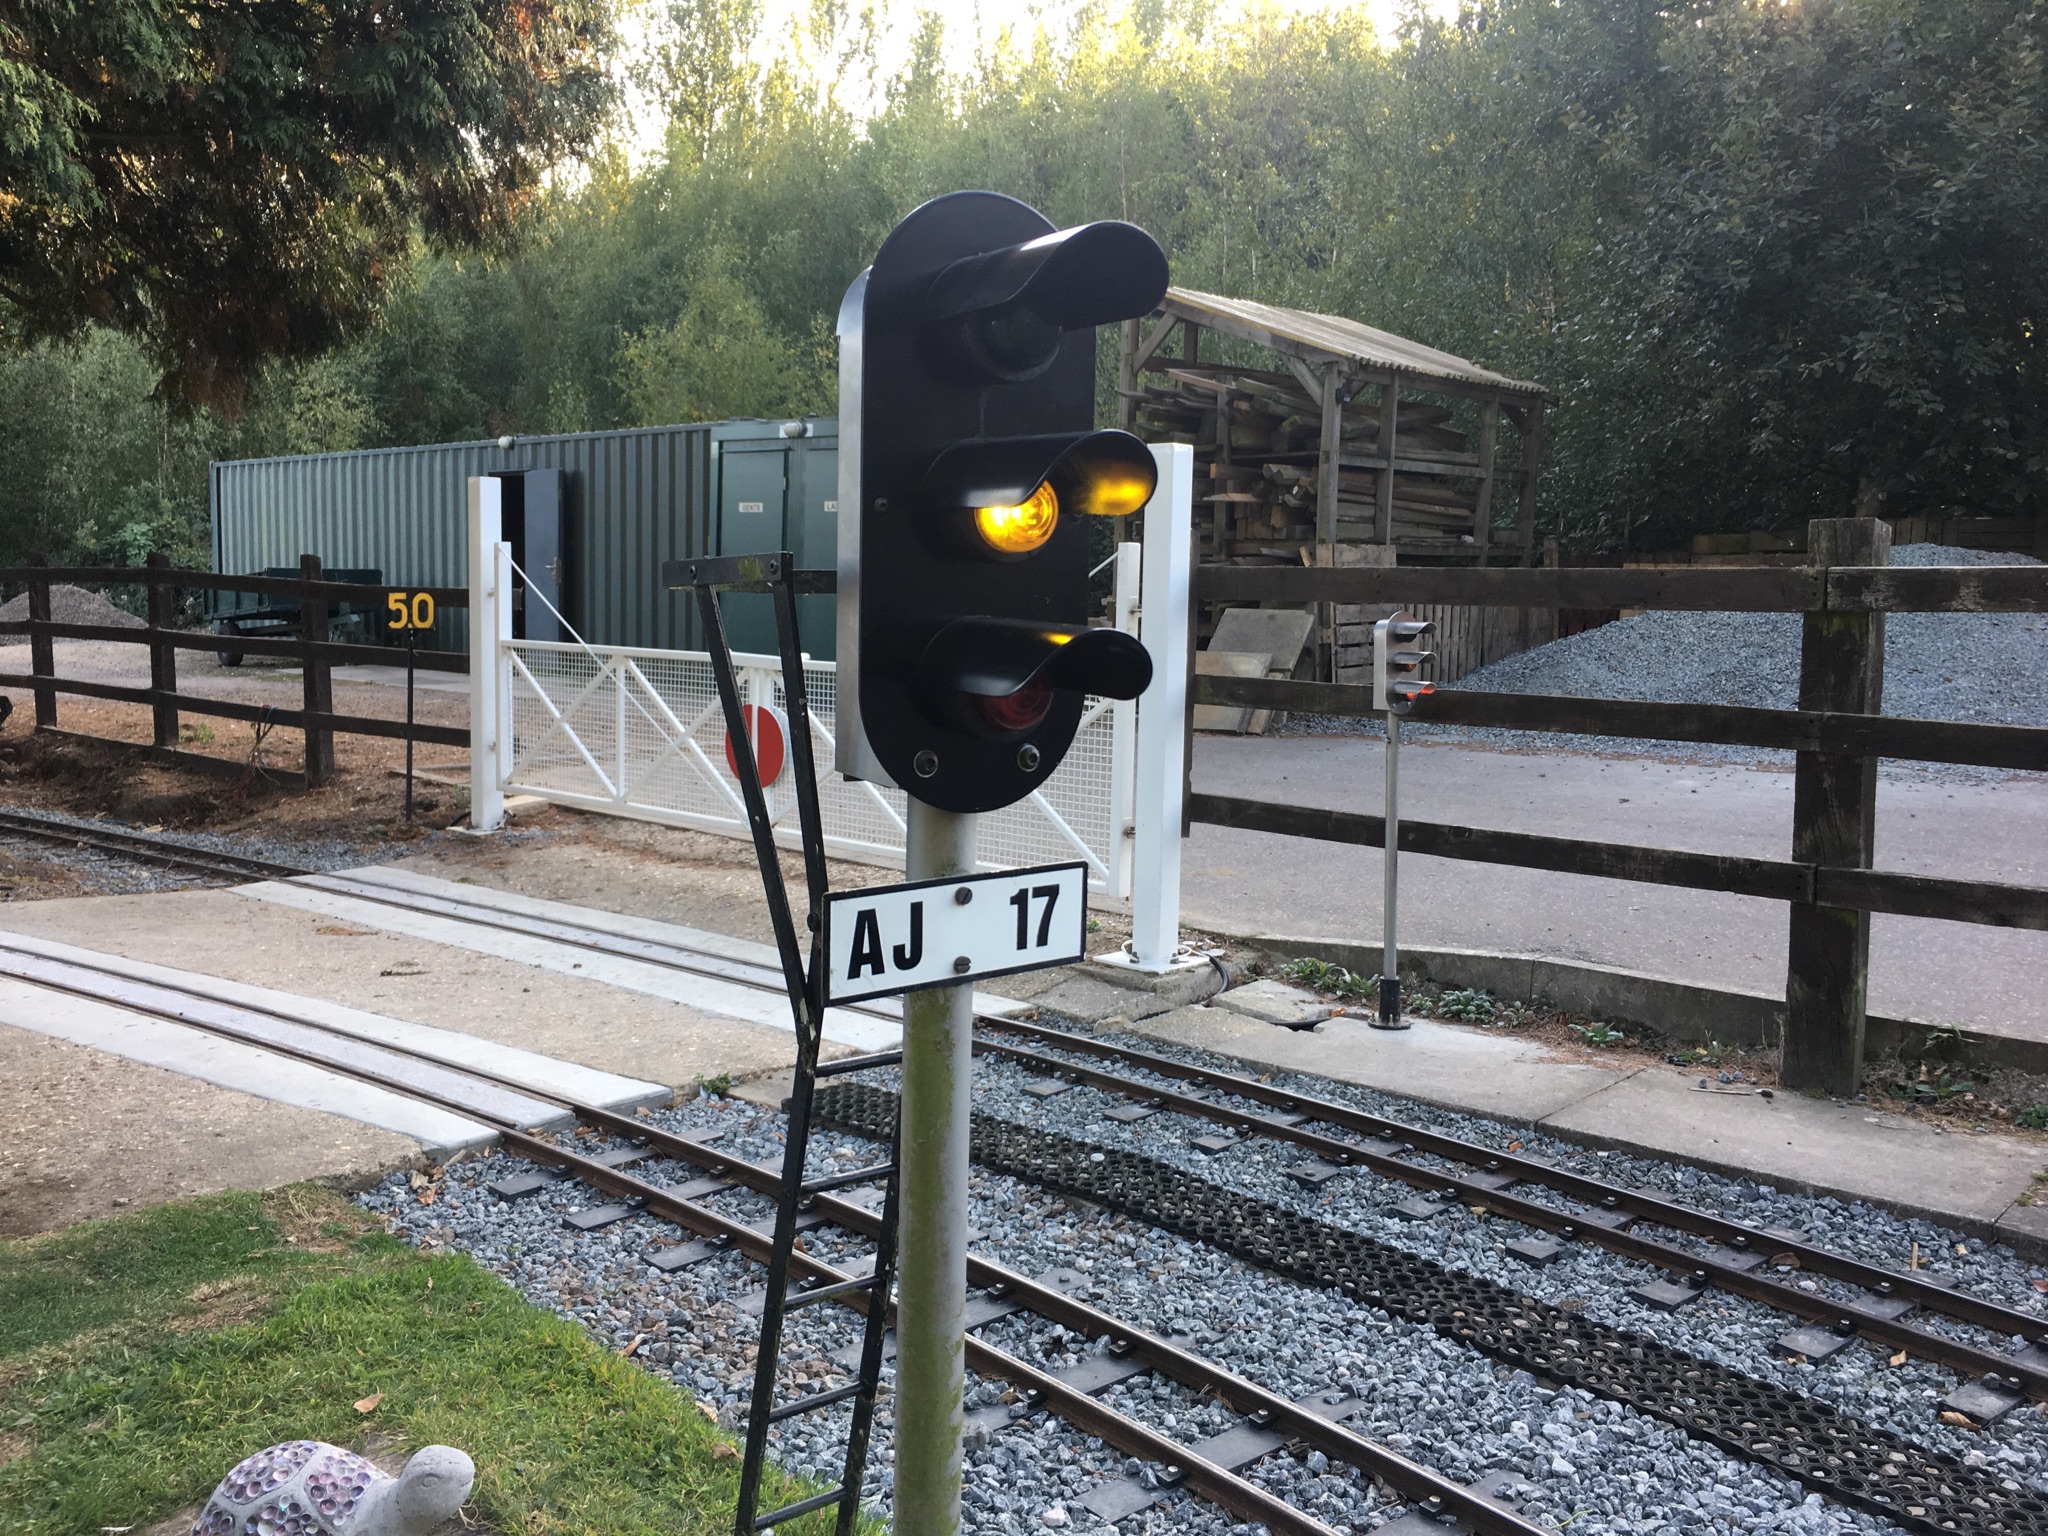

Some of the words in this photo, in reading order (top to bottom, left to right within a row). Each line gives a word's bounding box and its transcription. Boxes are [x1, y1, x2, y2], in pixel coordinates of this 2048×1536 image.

[742, 503, 761, 511] GENTS
[847, 901, 924, 980] AJ
[1009, 884, 1060, 951] 17
